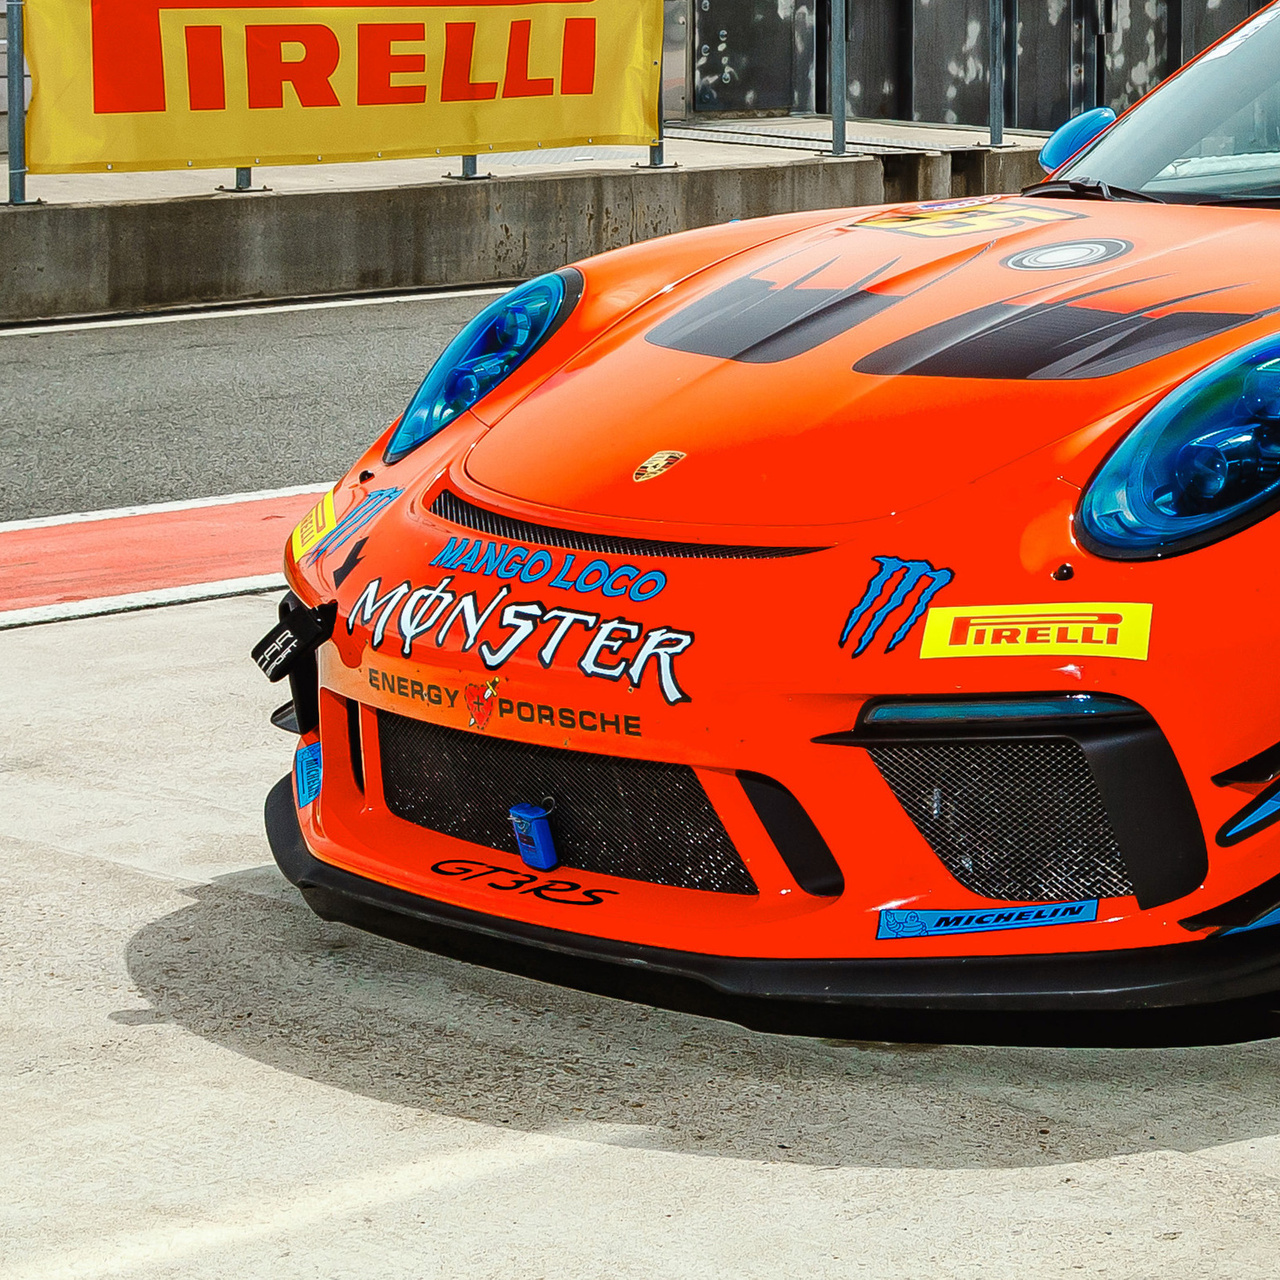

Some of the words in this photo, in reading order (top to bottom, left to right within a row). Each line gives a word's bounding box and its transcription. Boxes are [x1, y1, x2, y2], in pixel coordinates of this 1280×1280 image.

[430, 536, 553, 583] MANGO
[548, 554, 668, 602] LOCO
[948, 613, 1124, 646] PIRELLI
[368, 667, 460, 708] ENERGY
[498, 698, 642, 737] PORSCHE
[430, 859, 620, 906] GT3RS
[934, 905, 1086, 928] MICHELIN
